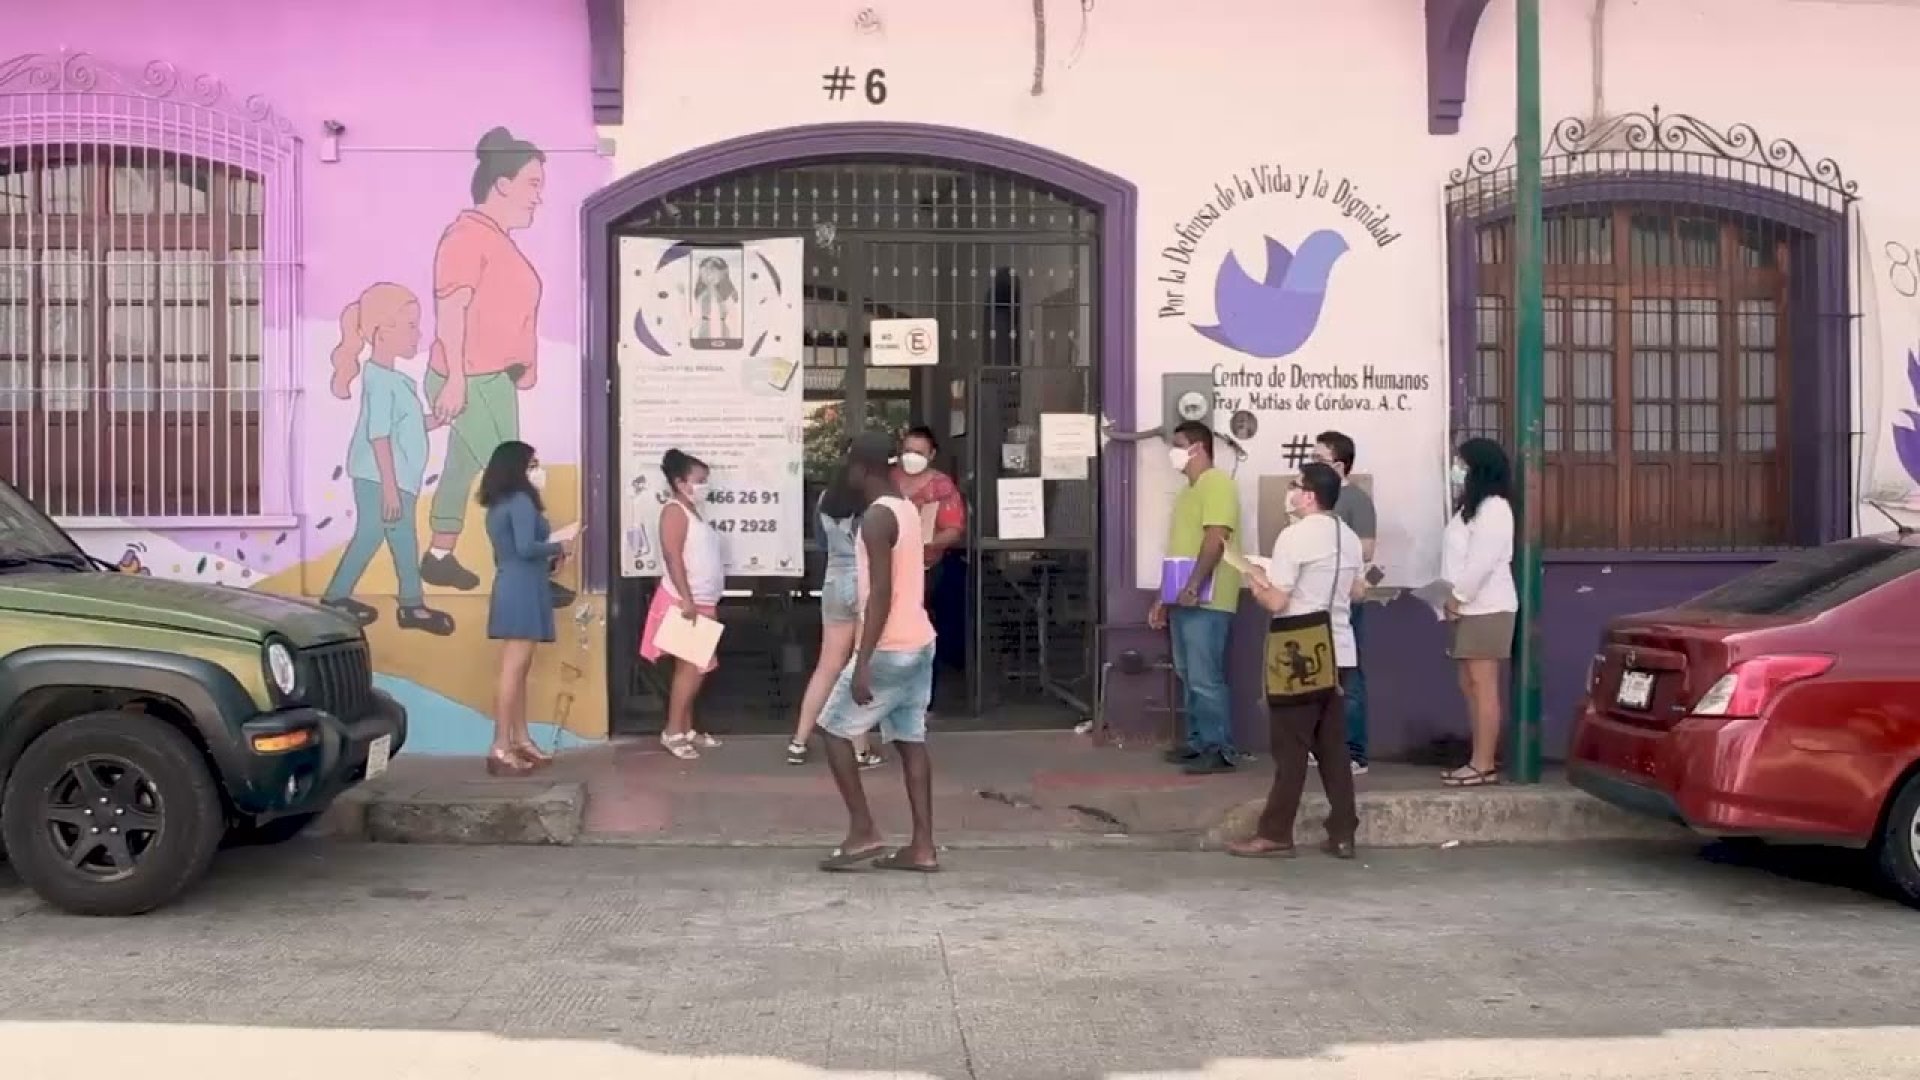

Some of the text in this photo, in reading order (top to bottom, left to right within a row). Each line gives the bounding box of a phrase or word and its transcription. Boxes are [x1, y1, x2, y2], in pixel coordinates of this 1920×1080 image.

[1158, 165, 1402, 318] Por la Defensa de la Vida y la Dignidad
[1885, 241, 1920, 297] 8
[1211, 363, 1430, 391] Centro de Derechos Humanos
[1213, 391, 1241, 414] Fray
[1295, 393, 1310, 411] de
[705, 491, 780, 505] 466 26 91
[740, 519, 778, 533] 2928
